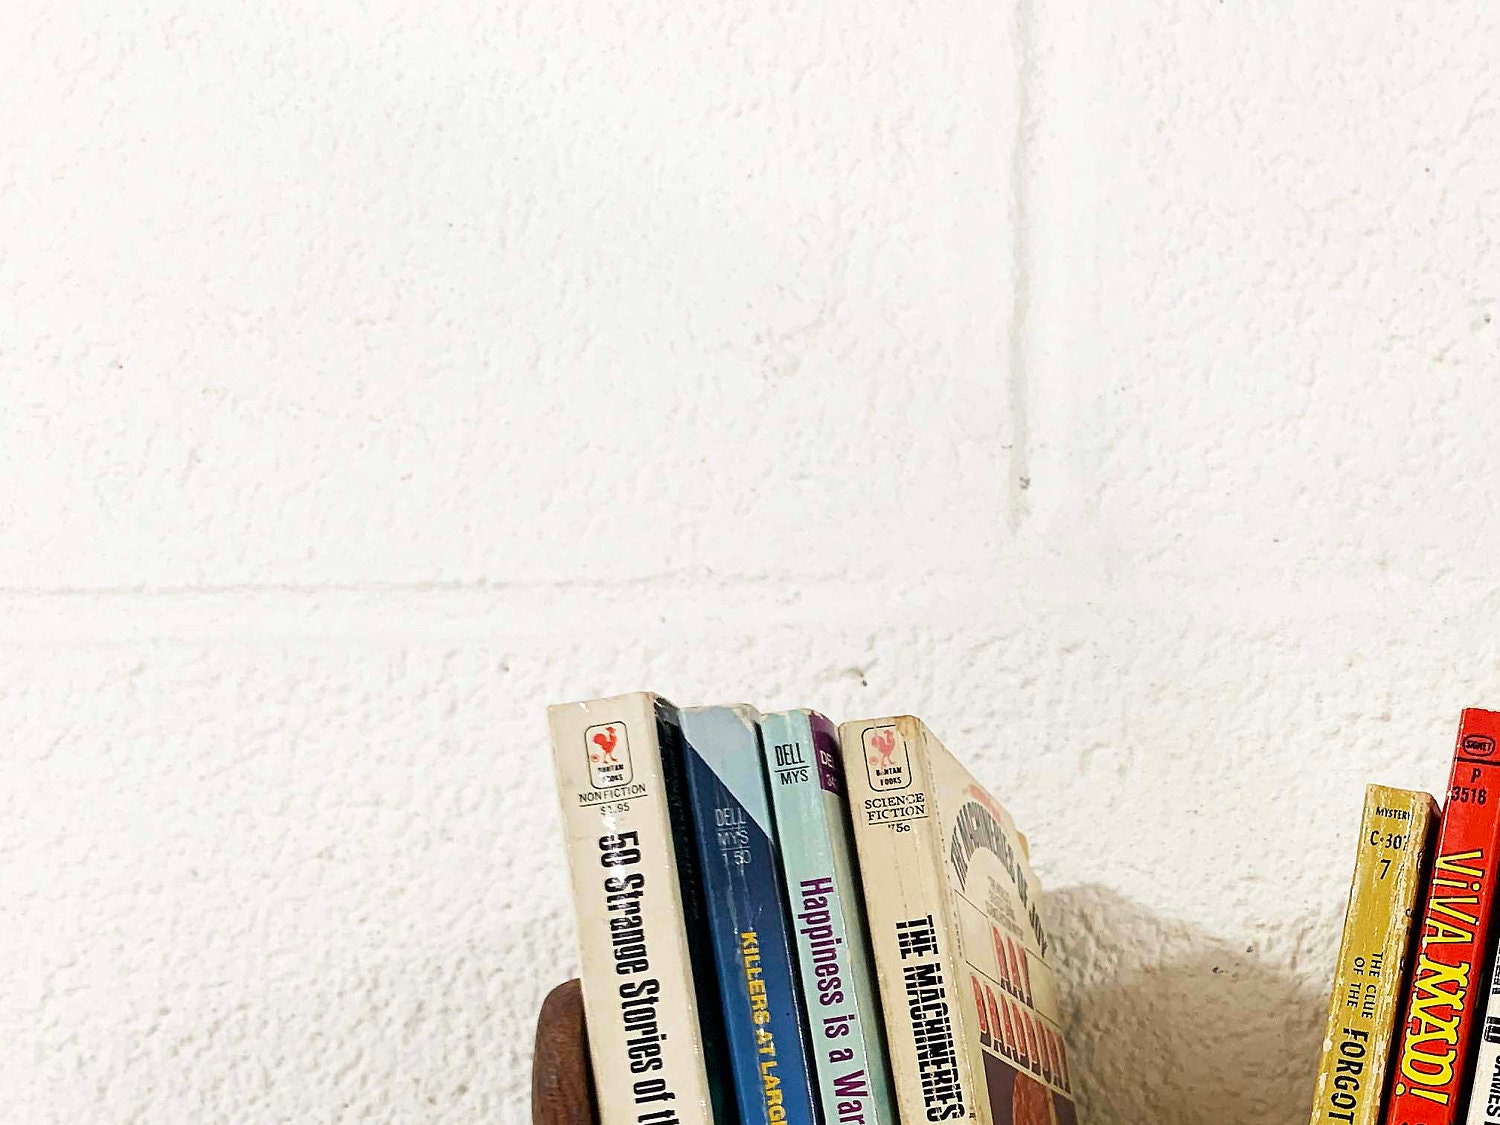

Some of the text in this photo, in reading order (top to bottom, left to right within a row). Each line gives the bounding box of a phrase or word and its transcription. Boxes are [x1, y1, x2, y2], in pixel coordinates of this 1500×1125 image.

[775, 742, 805, 767] DELL
[780, 769, 808, 786] MYS
[1470, 768, 1482, 784] P
[864, 792, 925, 810] SCIENCE
[1451, 786, 1487, 804] 3518
[715, 807, 746, 828] DELL
[866, 804, 925, 822] FICTION
[599, 830, 641, 868] 50
[717, 829, 749, 847] MYS
[1380, 858, 1391, 880] 7
[604, 872, 650, 976] Strange
[896, 914, 939, 960] THE
[798, 876, 845, 1006] Happiness
[740, 932, 771, 1025] KILLERS
[1347, 957, 1365, 1009] OF THE
[1361, 951, 1384, 1019] THE CLUE
[619, 979, 667, 1074] Stories
[823, 1014, 856, 1040] is
[1394, 953, 1470, 1105] MAD!
[755, 1028, 776, 1057] AT
[829, 1047, 854, 1064] a
[903, 962, 967, 1122] MACHINERIES
[634, 1076, 675, 1111] of
